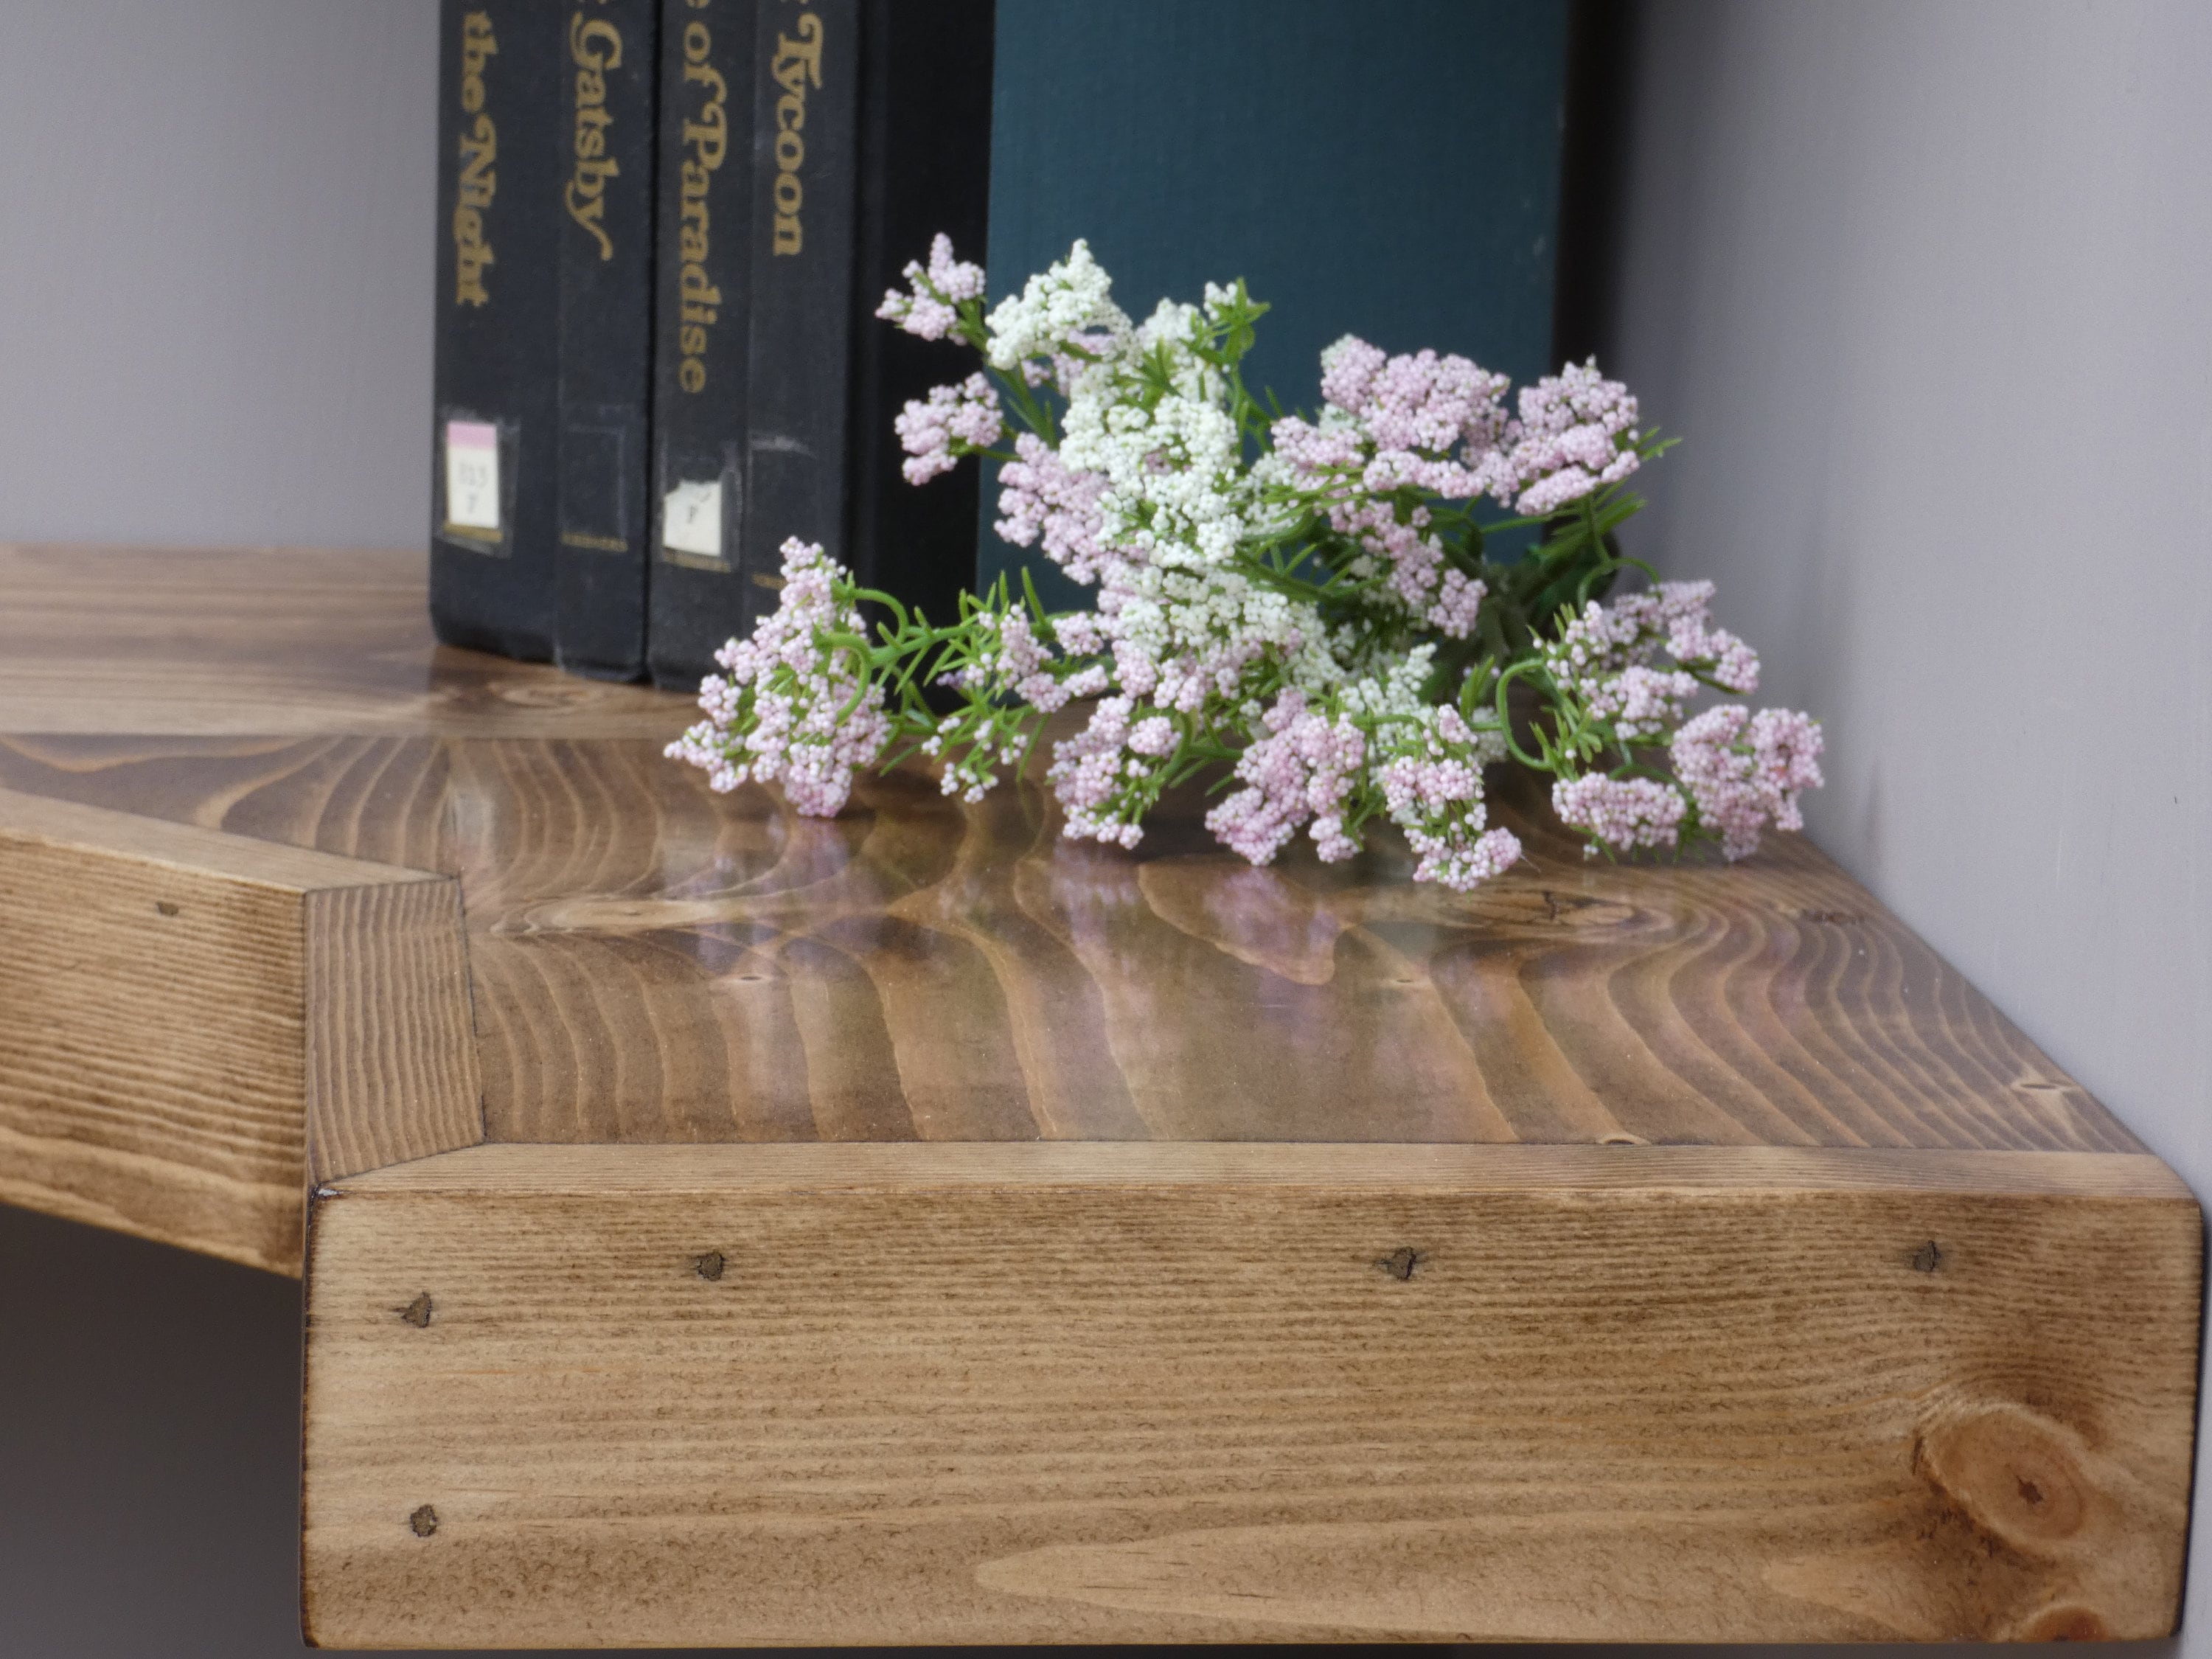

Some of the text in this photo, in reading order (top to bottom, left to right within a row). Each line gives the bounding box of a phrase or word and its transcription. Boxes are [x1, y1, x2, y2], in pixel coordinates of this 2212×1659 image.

[453, 12, 498, 307] the Night
[566, 12, 622, 261] Gatsby
[684, 21, 727, 104] of
[771, 13, 824, 257] Tycoon
[679, 103, 727, 394] Paradise
